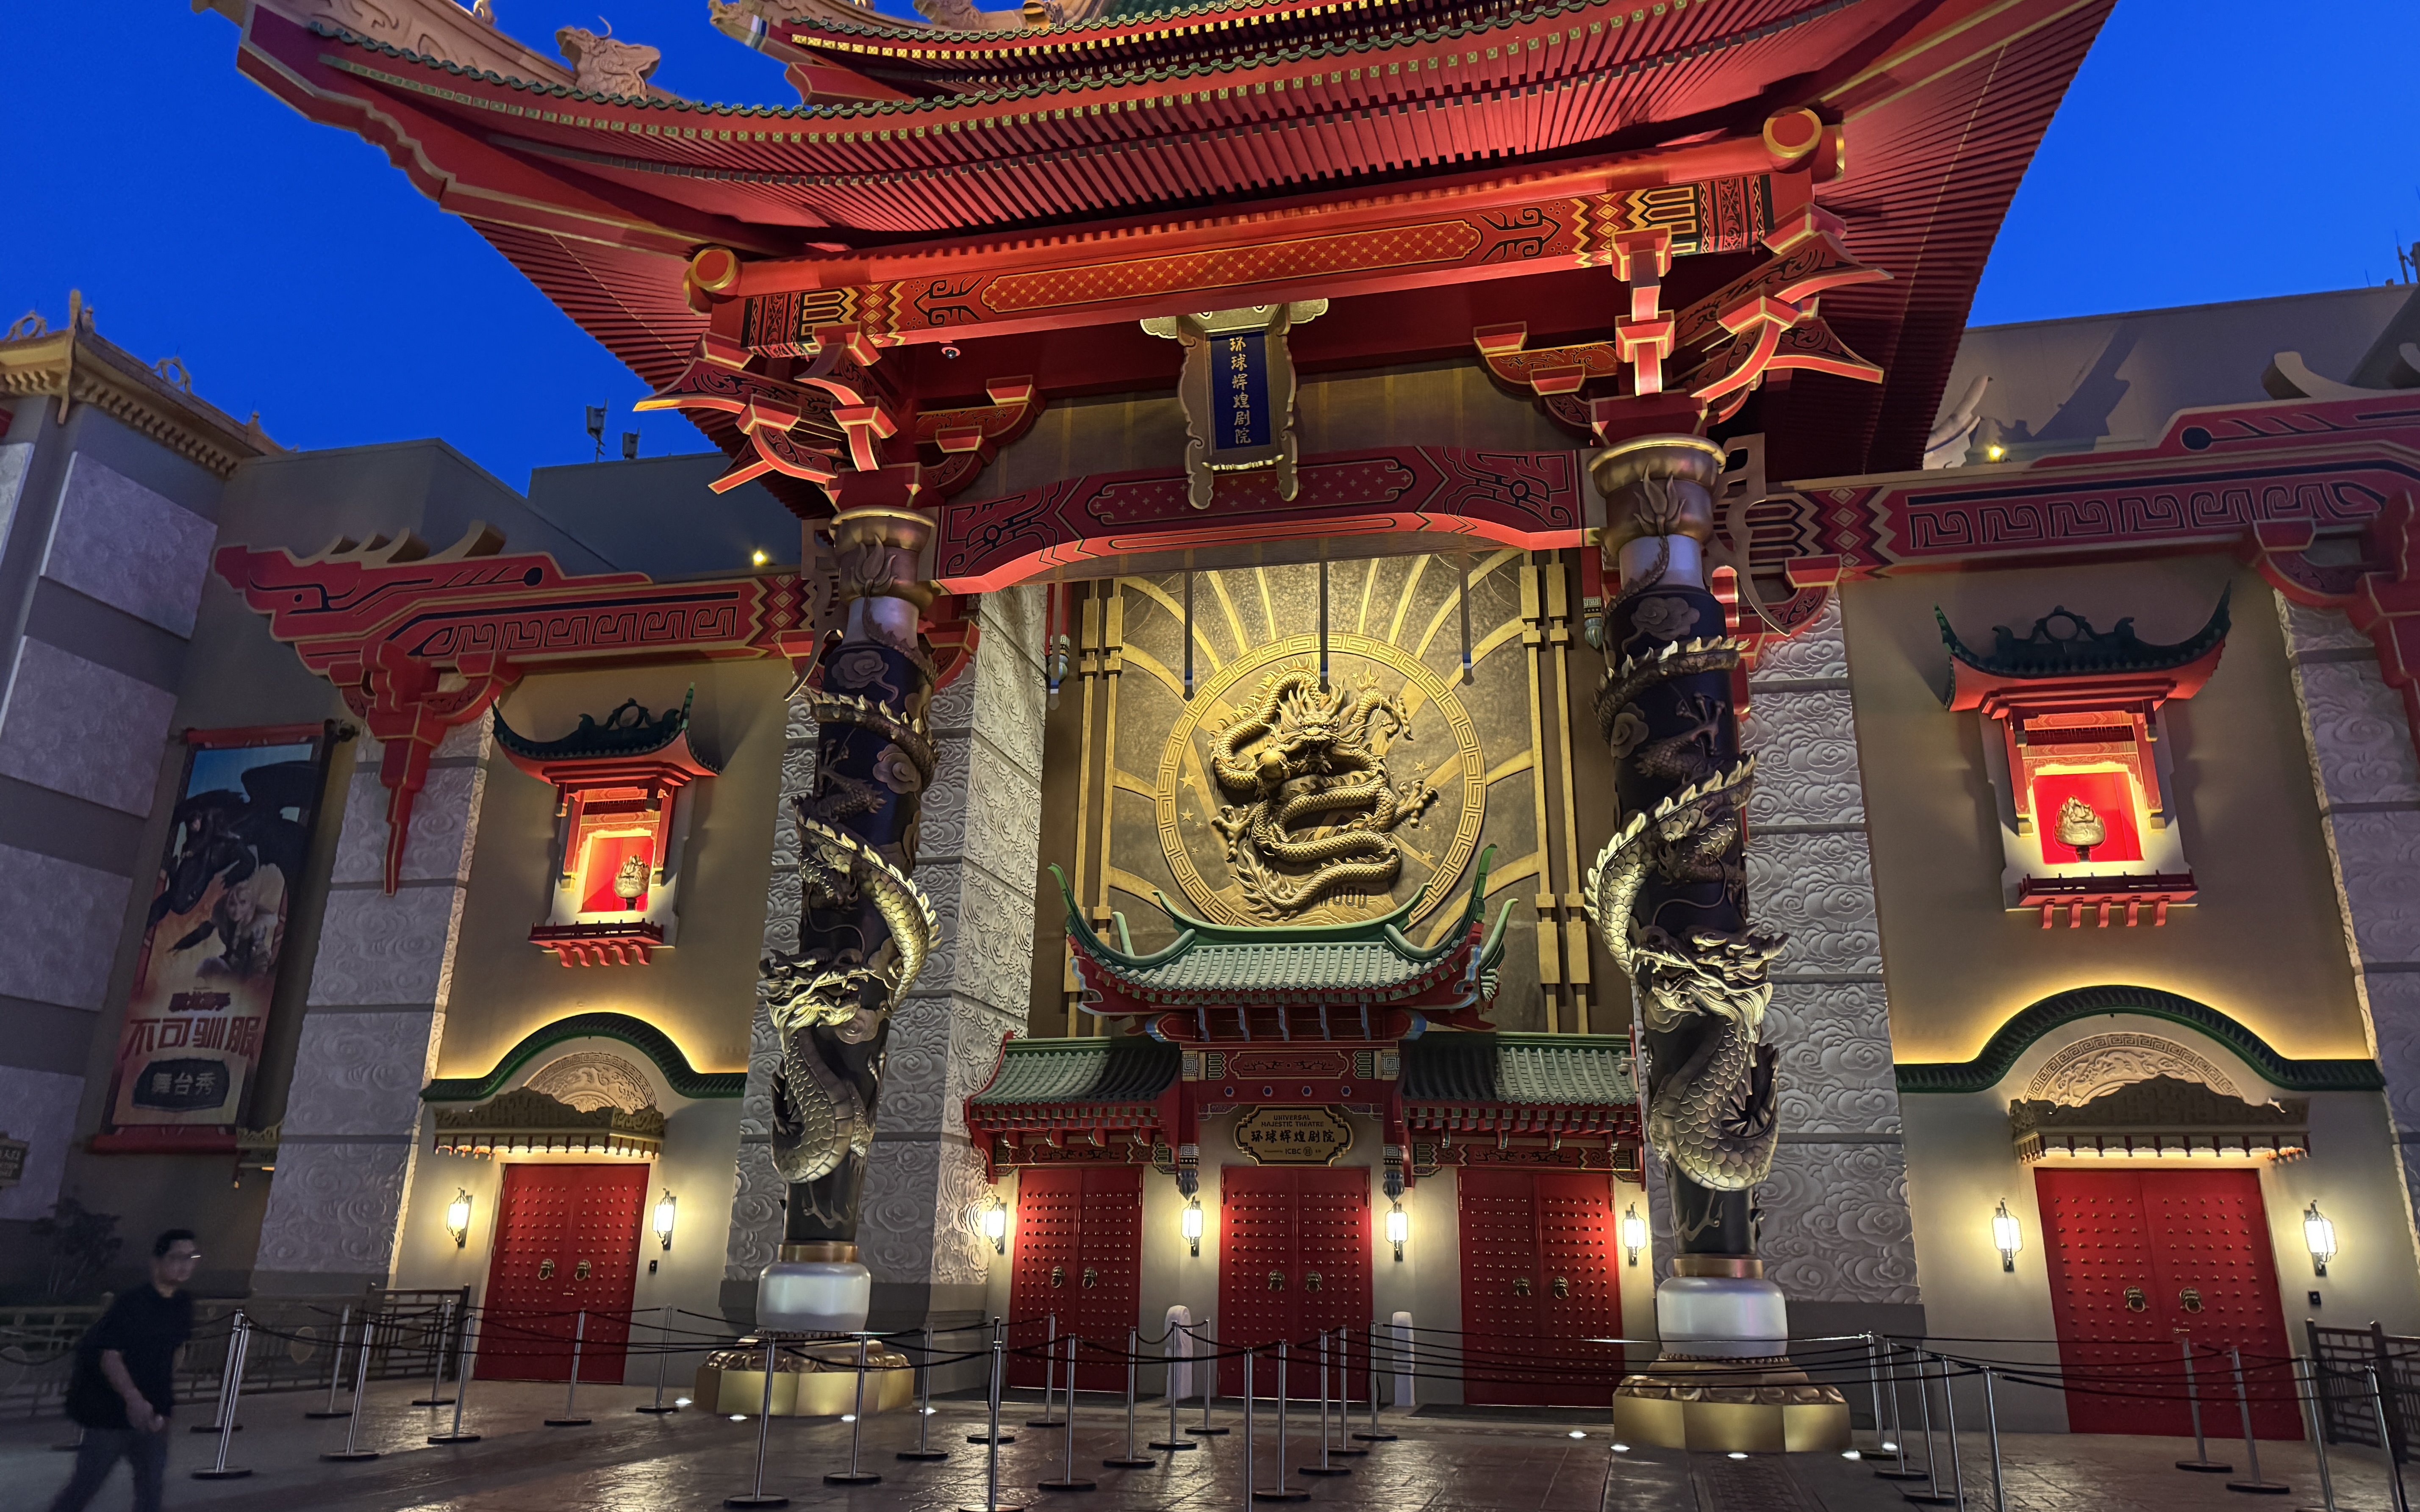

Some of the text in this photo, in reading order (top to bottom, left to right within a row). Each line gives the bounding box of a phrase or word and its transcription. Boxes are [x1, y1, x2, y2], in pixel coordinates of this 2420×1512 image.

[1229, 336, 1252, 444] 环球辉煌剧院
[122, 1016, 261, 1061] 不可驯服
[1251, 1130, 1335, 1143] 环球辉煌剧院
